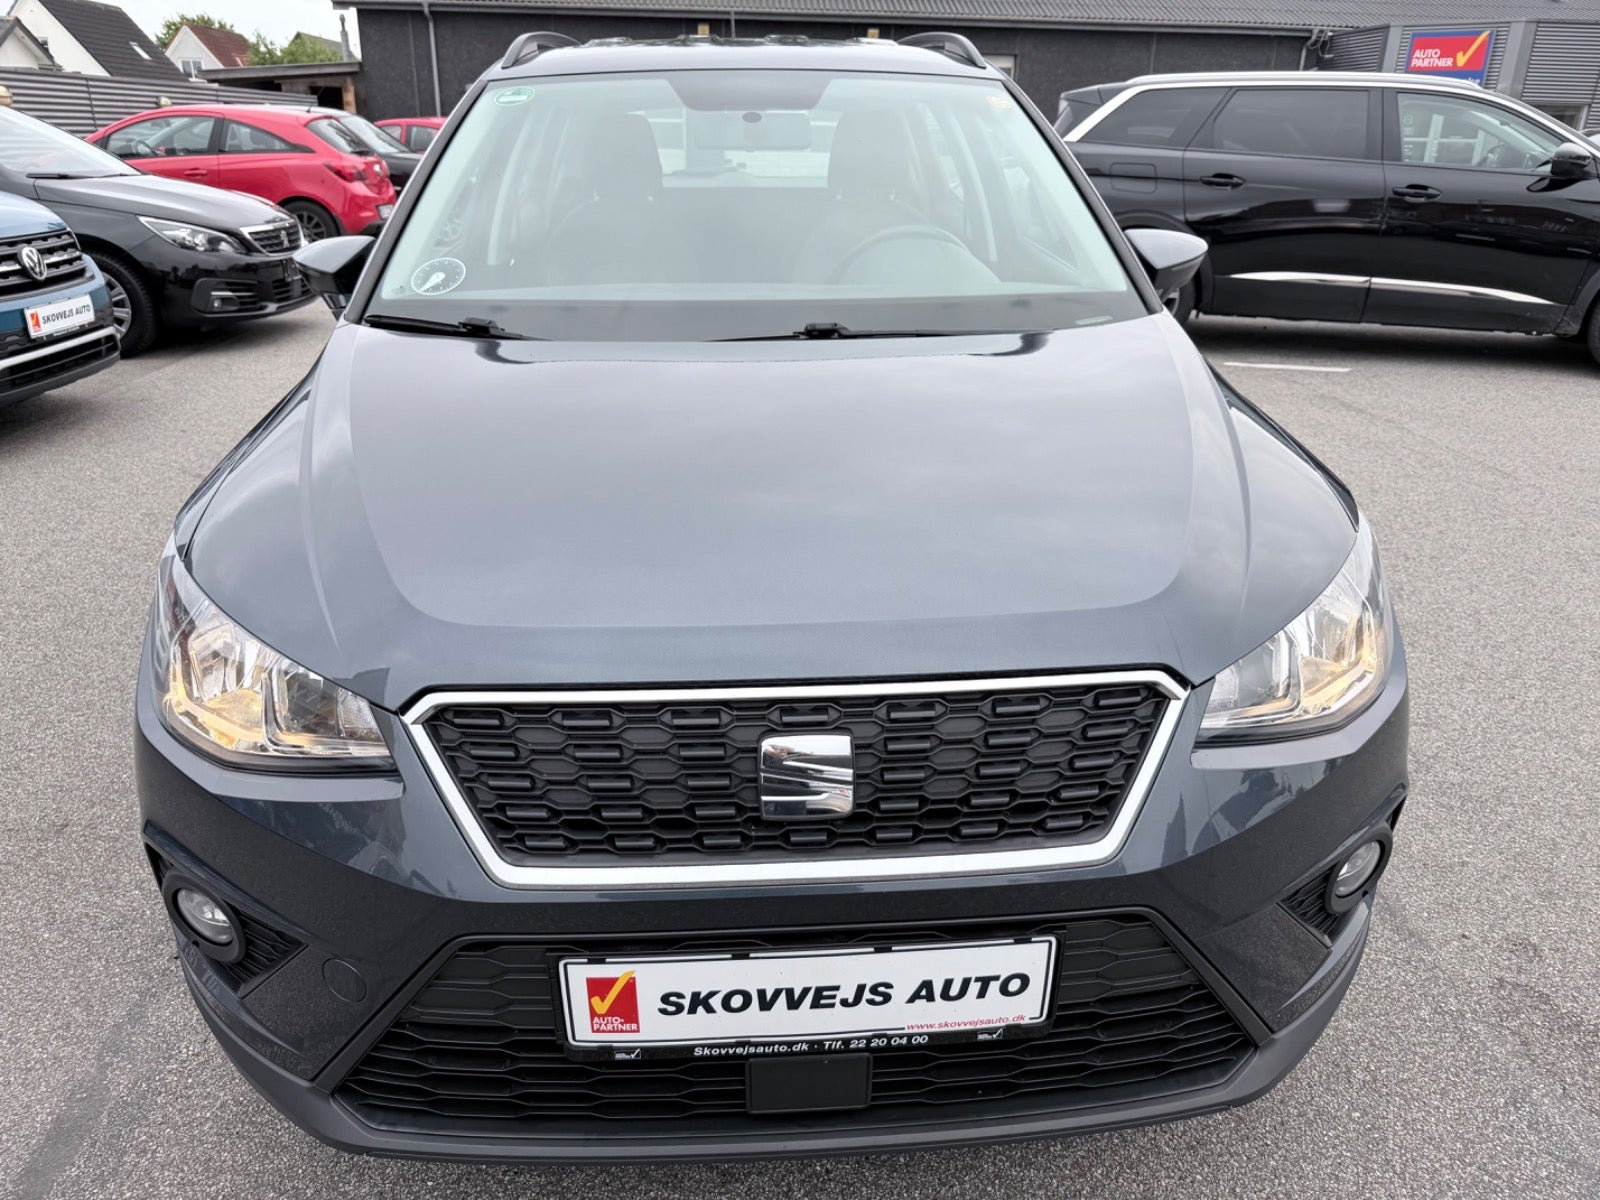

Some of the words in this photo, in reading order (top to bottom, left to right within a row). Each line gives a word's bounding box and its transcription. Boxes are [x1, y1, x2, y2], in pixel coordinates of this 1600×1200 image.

[1413, 48, 1441, 58] AUTO
[1411, 57, 1454, 67] PARTNER
[42, 310, 74, 325] SKOVVEJS
[75, 304, 91, 315] AUTO
[657, 981, 895, 1016] SKOVVEJS
[905, 972, 1031, 1004] AUTO
[593, 1023, 638, 1031] PARTNER
[906, 1014, 1026, 1031] www.skovvejsauto.dk
[693, 1042, 809, 1056] Skovvejsauto.dk
[823, 1040, 844, 1050] Tlf.
[849, 1039, 867, 1049] 22
[870, 1037, 887, 1047] 20
[891, 1035, 908, 1046] 04
[911, 1034, 929, 1044] 00
